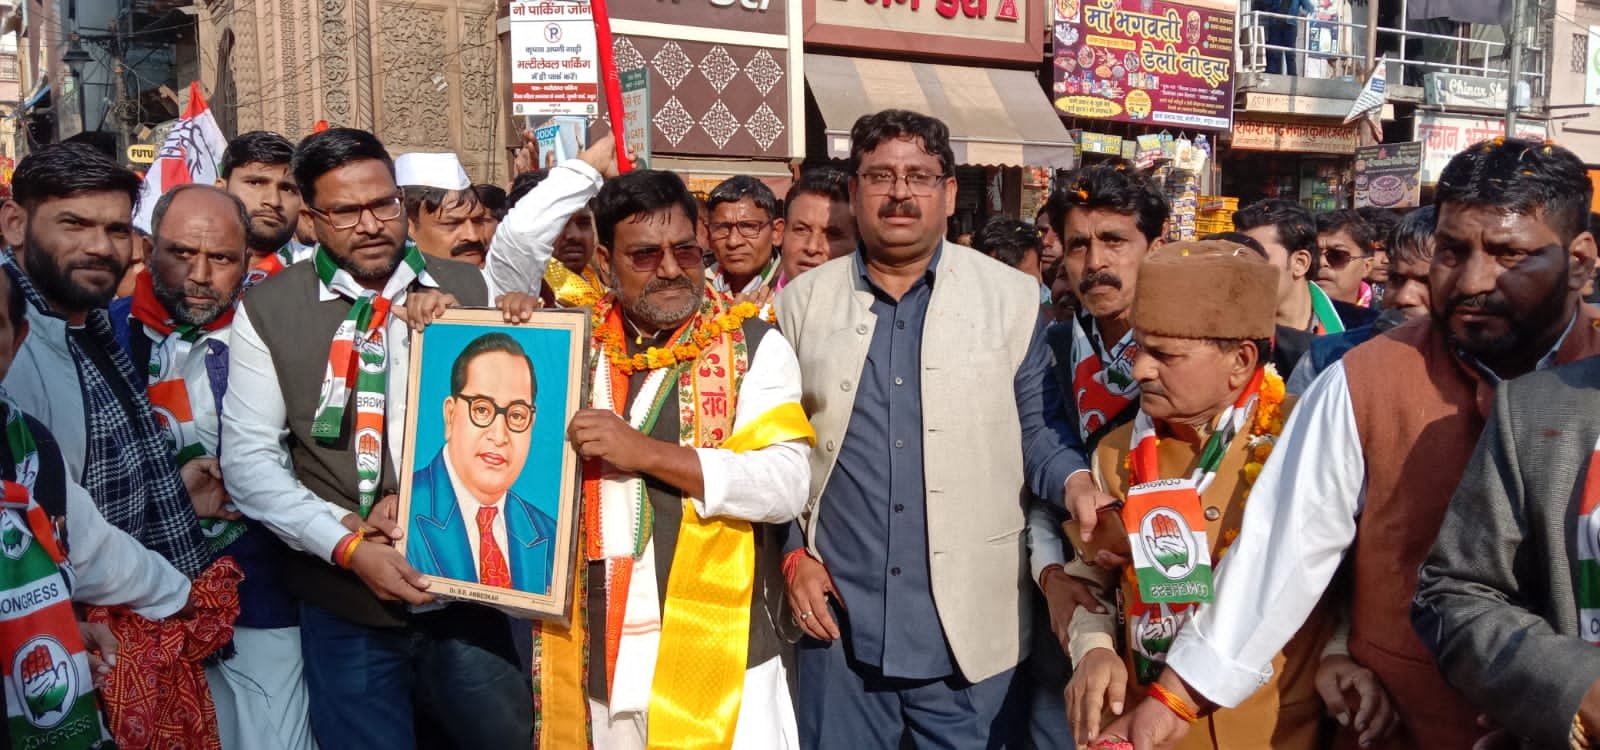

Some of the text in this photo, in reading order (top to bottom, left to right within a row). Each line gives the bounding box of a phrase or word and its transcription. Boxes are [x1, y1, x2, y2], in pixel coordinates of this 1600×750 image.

[513, 0, 592, 16] नो पार्किंग जोन
[1086, 0, 1112, 31] माँ
[1116, 9, 1181, 40] भगवती
[561, 56, 591, 69] पार्किंग
[1142, 42, 1177, 72] डेली
[1181, 45, 1229, 85] नीड्स
[0, 582, 59, 615] ONGRESS
